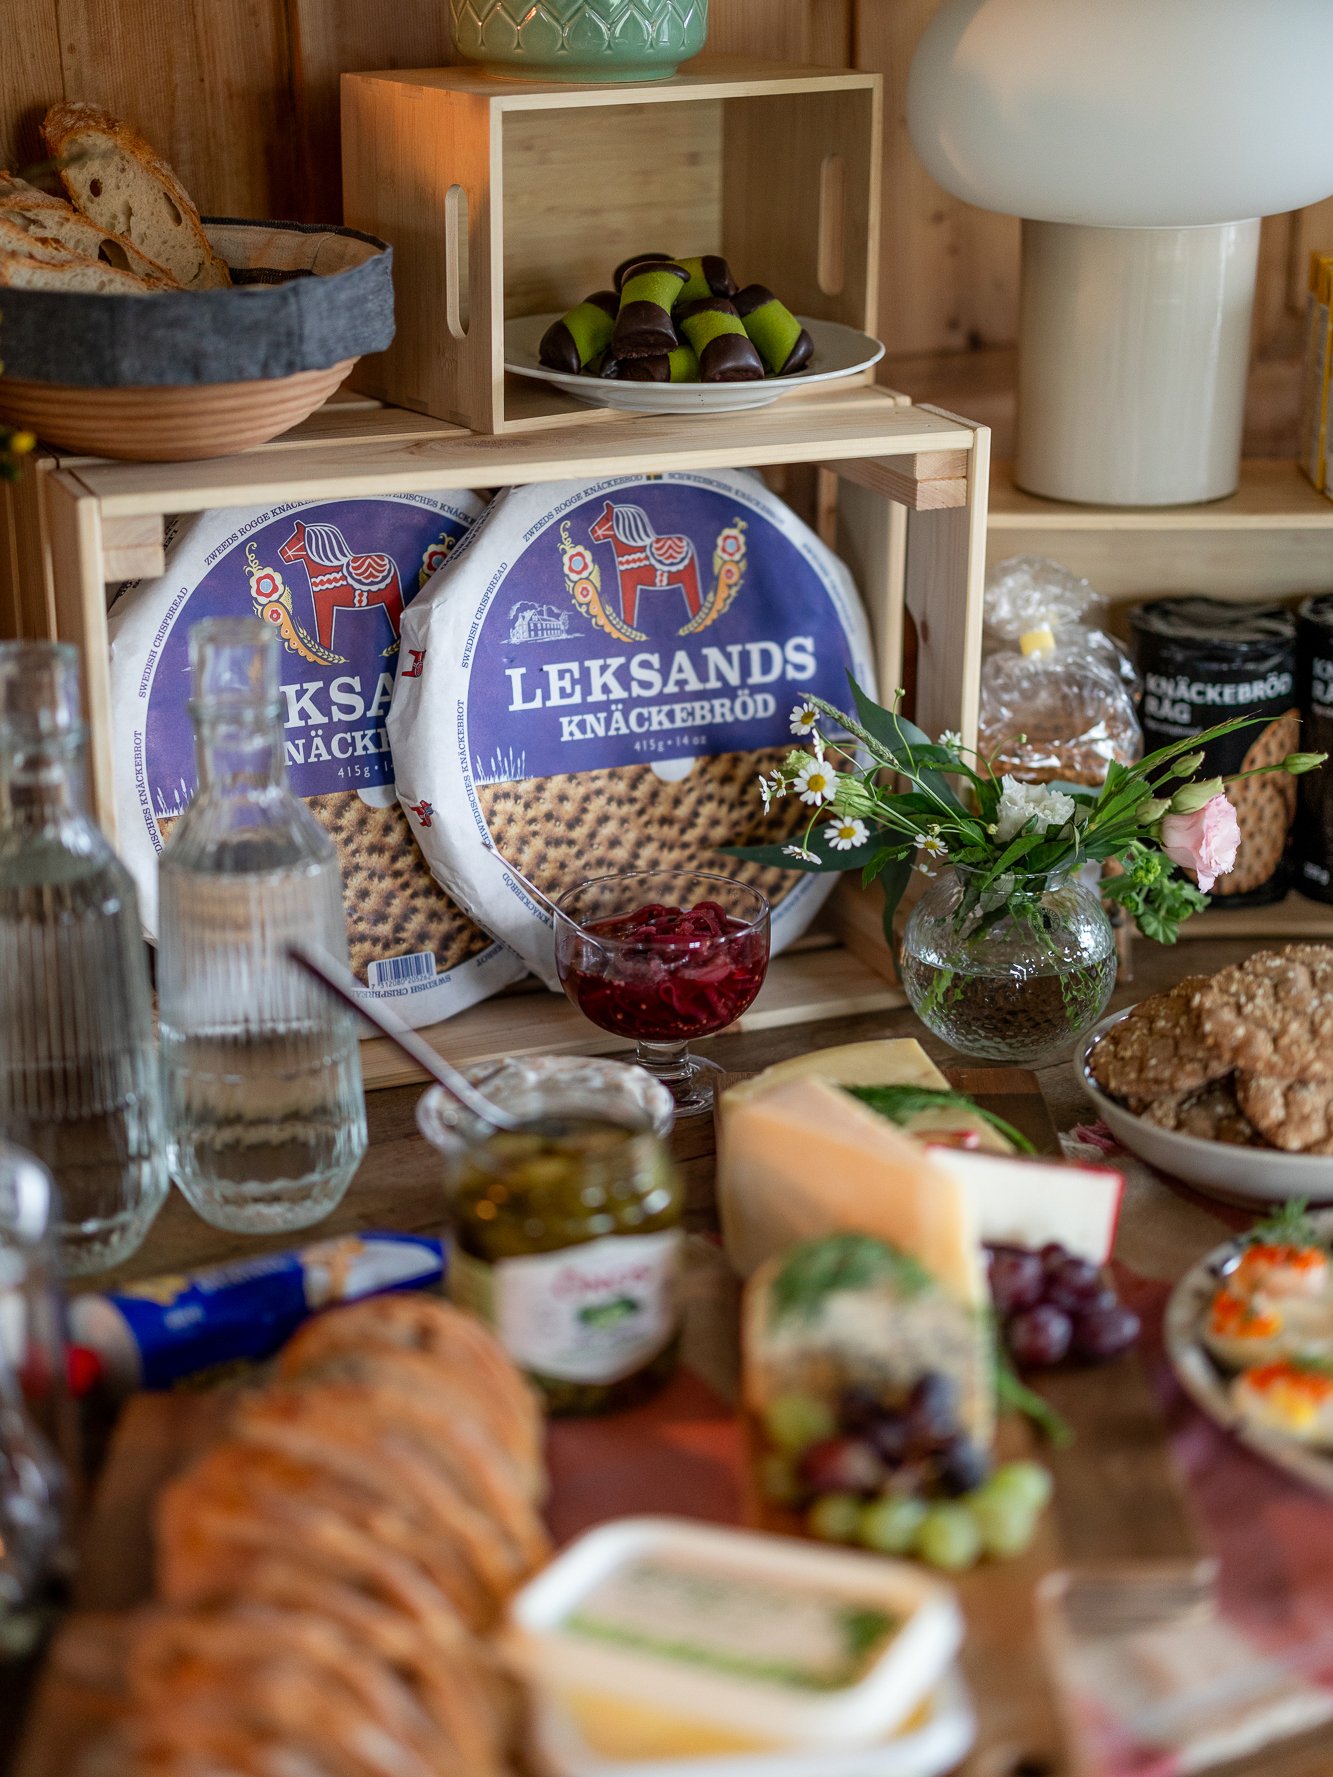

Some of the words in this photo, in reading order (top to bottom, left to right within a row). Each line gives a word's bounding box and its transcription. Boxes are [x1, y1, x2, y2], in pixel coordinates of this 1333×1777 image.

[204, 532, 239, 566] ZWEEDS
[238, 511, 271, 537] ROGGE
[523, 511, 554, 542] ZWEEDS
[554, 493, 583, 514] ROGGE
[138, 649, 158, 698] SWEDISH
[153, 586, 188, 648] CRISPBREAD
[462, 622, 479, 669] SWEDISH
[475, 561, 508, 621] CRISPBREAD
[504, 635, 818, 712] LEKSANDS
[1146, 671, 1293, 705] KNÄCKEBRÖD
[457, 699, 469, 773] KNÄCKEBROT
[559, 689, 777, 742] KNÄCKEBRÖD
[1145, 695, 1192, 724] RÅG
[134, 730, 148, 806] KNÄCKEBROT
[338, 765, 371, 778] 415g
[410, 974, 452, 994] SWEDISH
